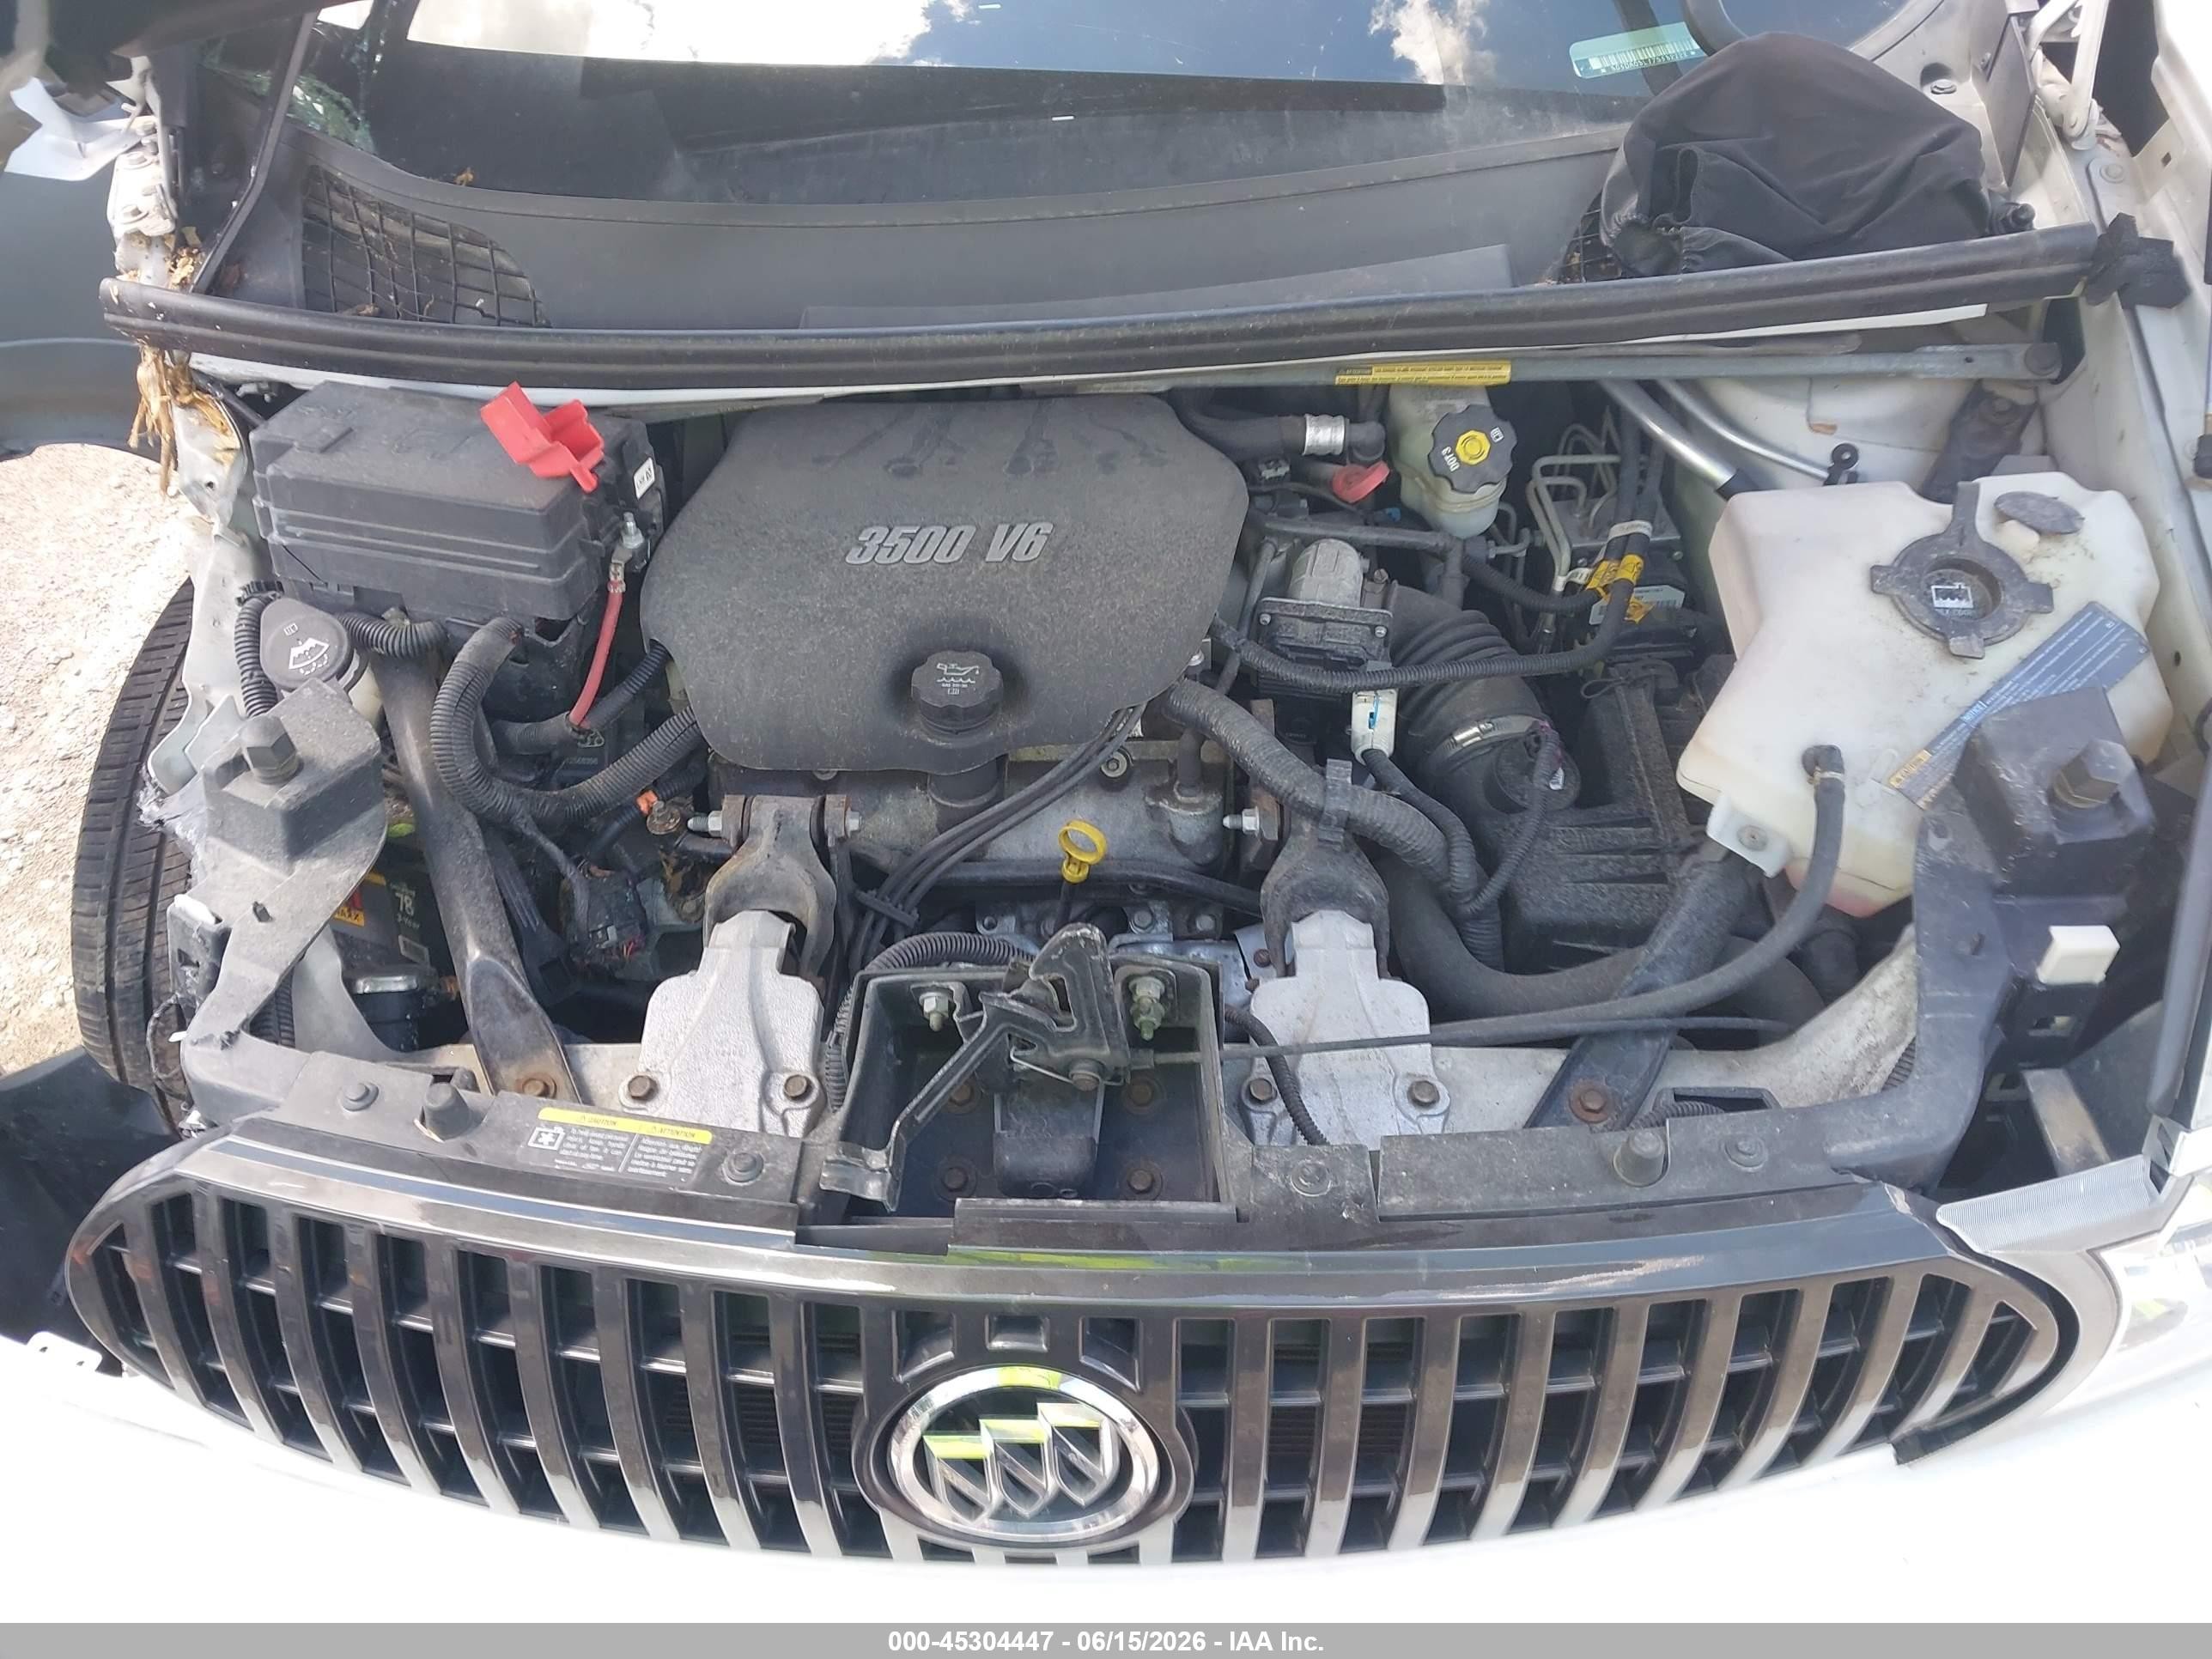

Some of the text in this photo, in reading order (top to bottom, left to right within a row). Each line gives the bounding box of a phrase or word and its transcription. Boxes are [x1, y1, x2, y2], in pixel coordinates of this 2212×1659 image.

[1441, 446, 1461, 472] DOT3
[845, 521, 1055, 565] 3500 V6
[395, 892, 415, 916] 78
